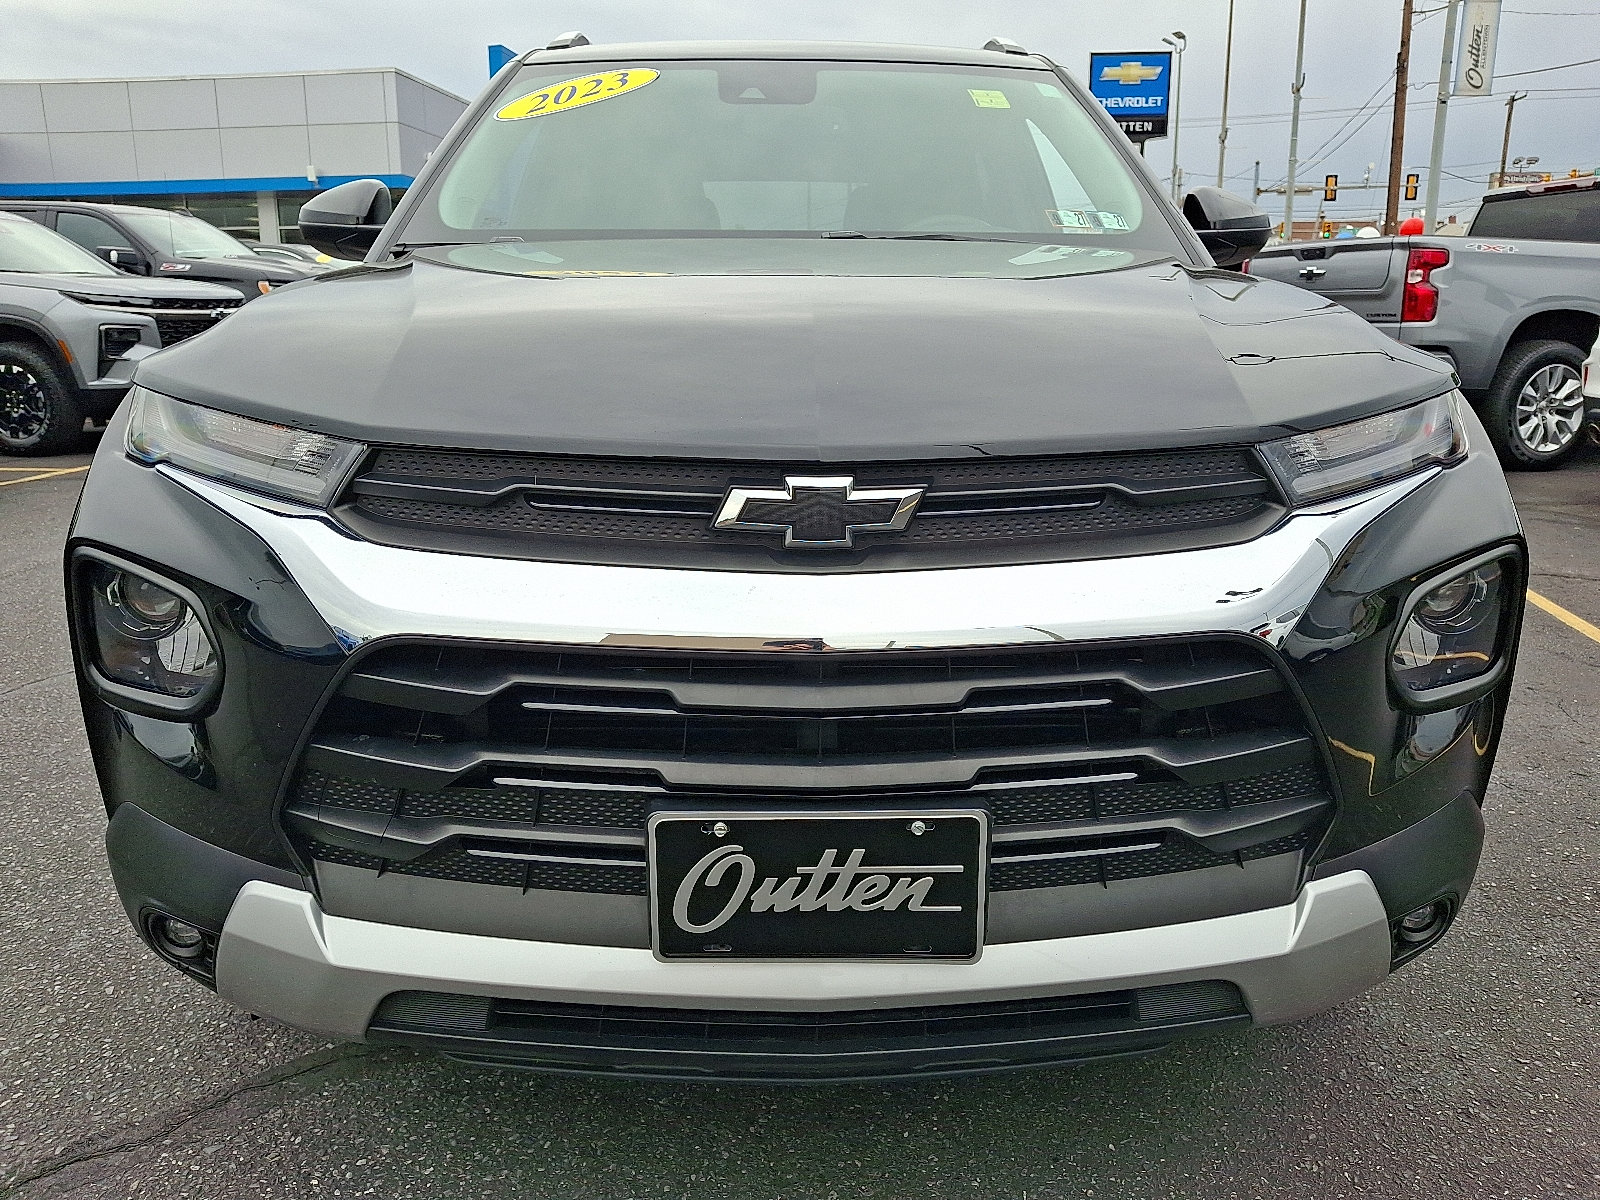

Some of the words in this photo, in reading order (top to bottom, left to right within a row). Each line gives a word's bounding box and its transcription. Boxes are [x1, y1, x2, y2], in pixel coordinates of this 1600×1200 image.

[1465, 25, 1484, 89] Outten
[525, 72, 629, 115] 2023
[1073, 212, 1087, 227] 27
[1112, 214, 1126, 228] 27
[673, 844, 964, 934] Outten
